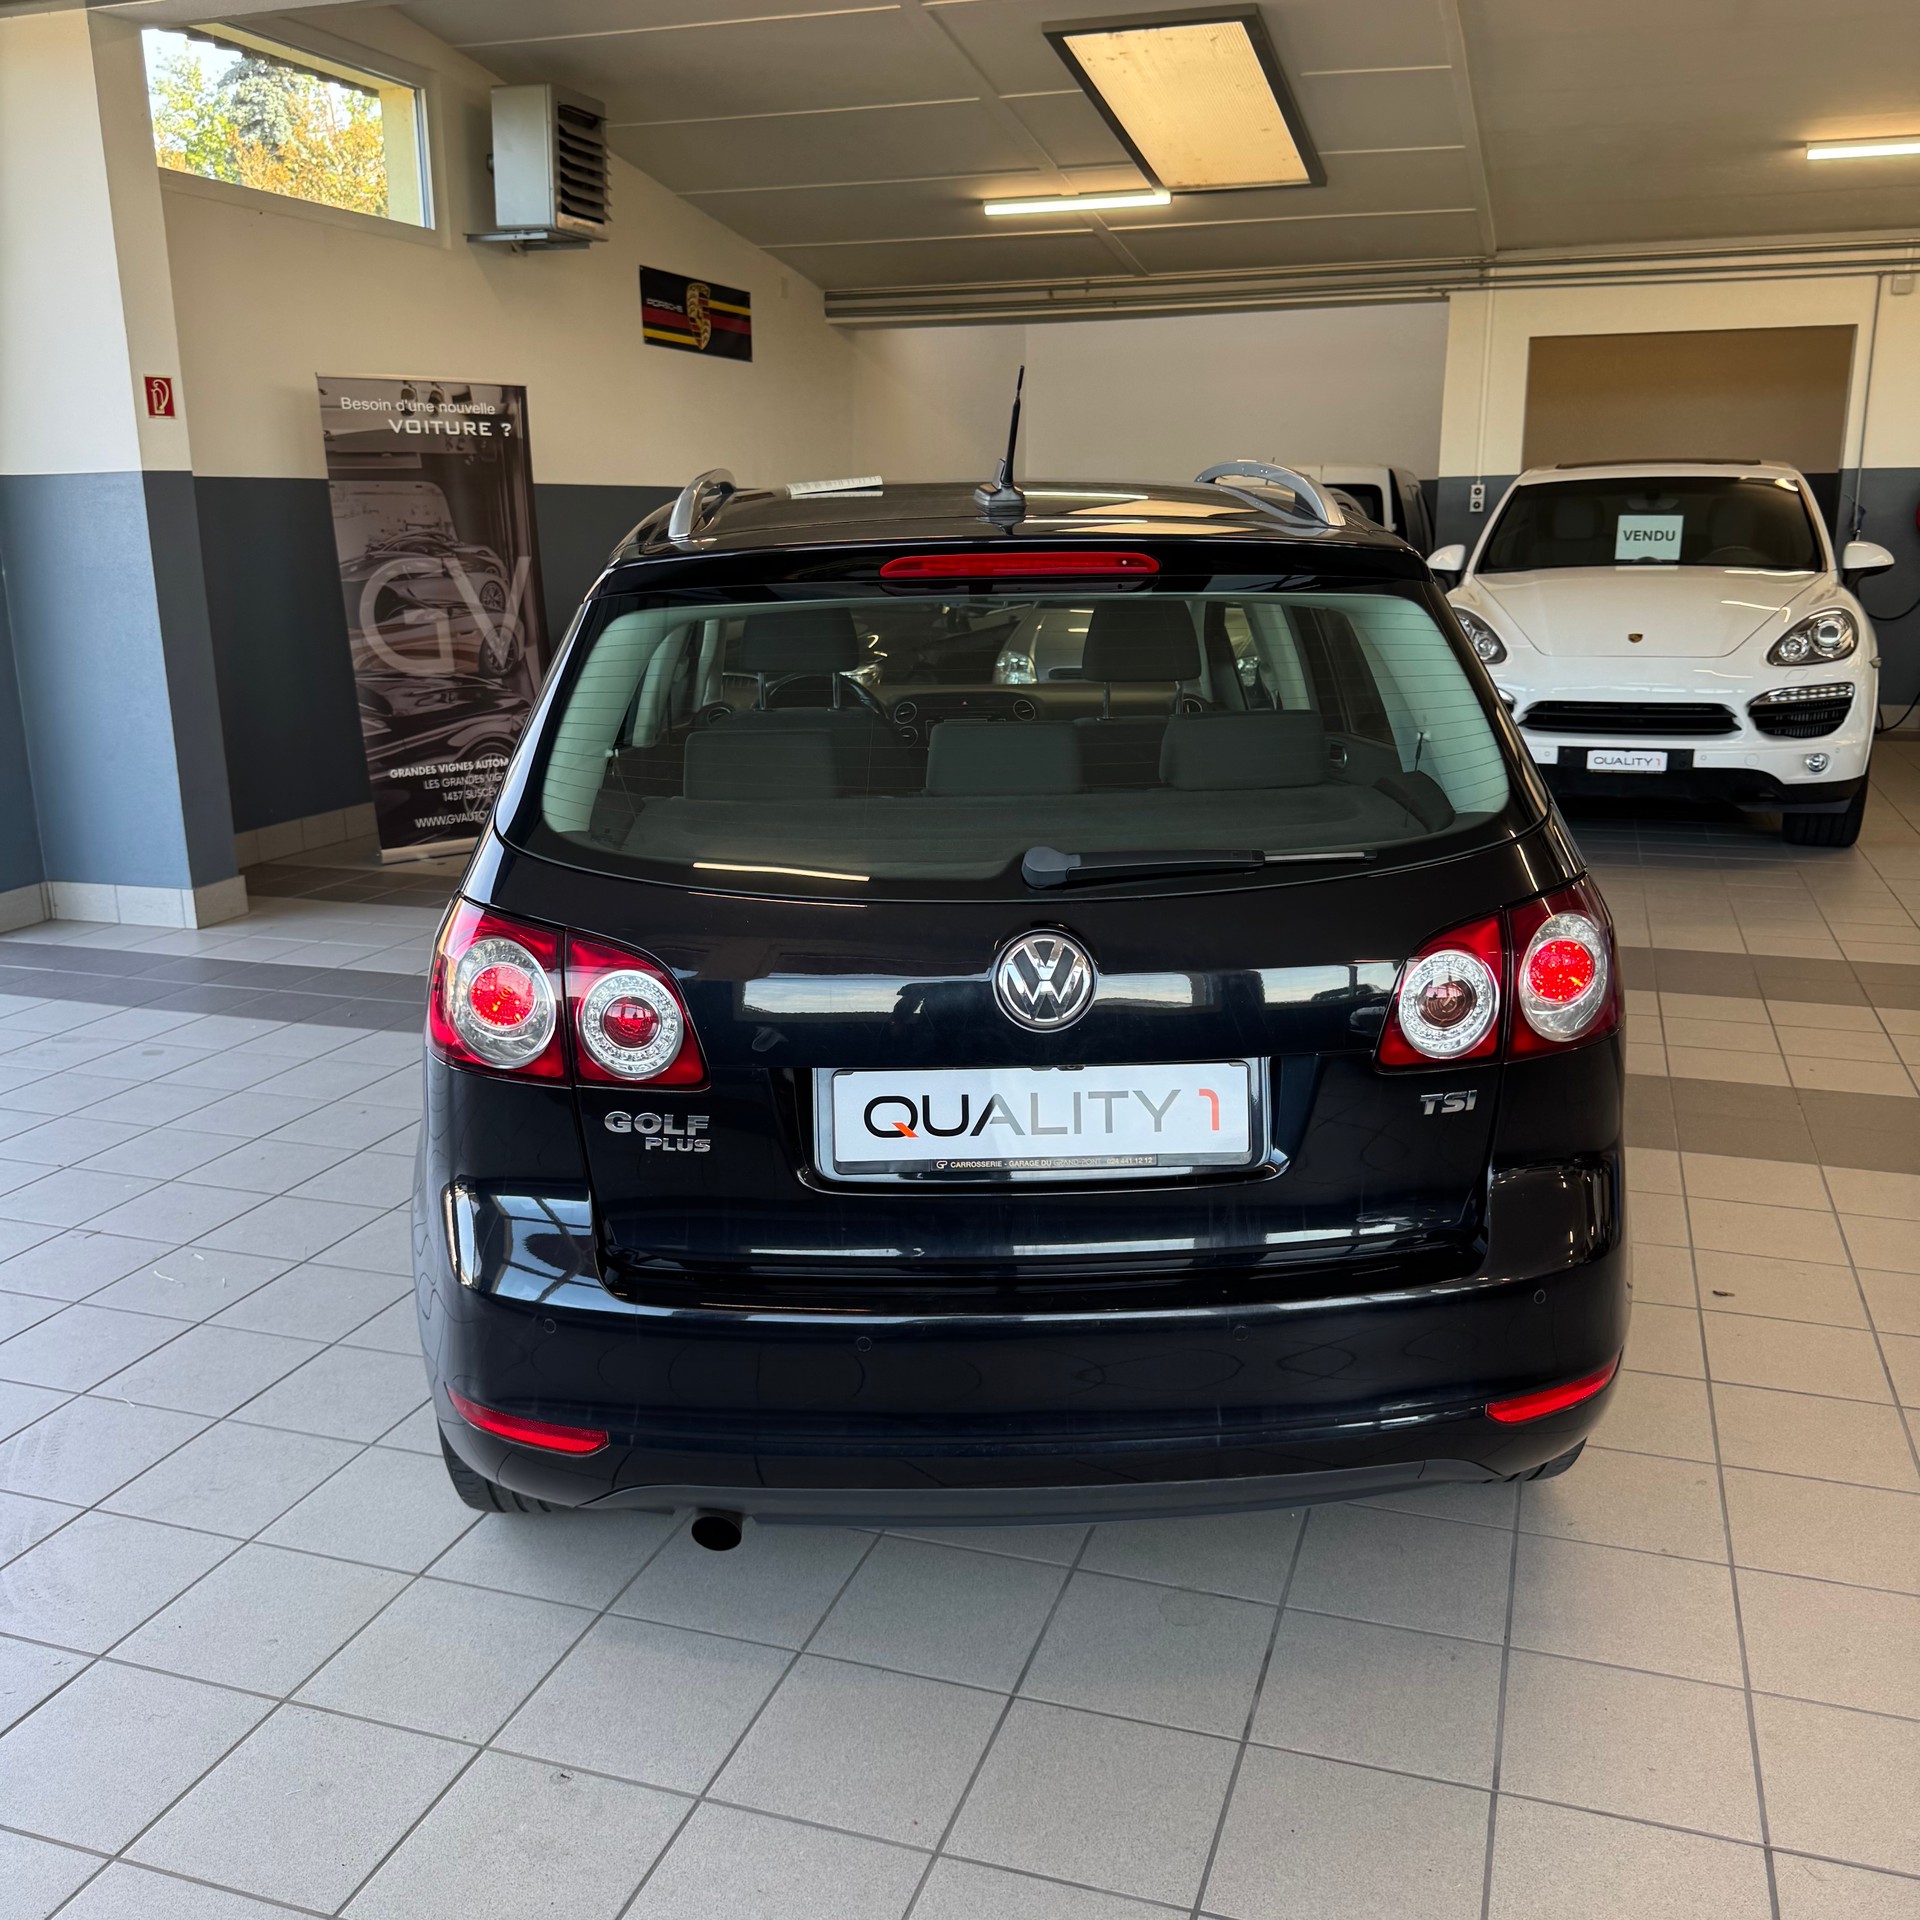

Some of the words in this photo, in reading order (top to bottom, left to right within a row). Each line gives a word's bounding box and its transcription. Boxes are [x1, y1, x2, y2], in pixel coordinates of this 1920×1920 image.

[340, 397, 392, 411] Besoin
[396, 399, 435, 413] d'une
[439, 402, 496, 415] nouvelle
[388, 419, 493, 436] VOITURE
[501, 423, 512, 437] ?
[1623, 530, 1676, 541] VENDU
[360, 556, 531, 676] GV
[390, 765, 437, 779] GRANDES
[438, 761, 474, 774] VIGNES
[1593, 756, 1653, 766] QUALITY
[1655, 758, 1661, 766] 1
[424, 779, 440, 790] LES
[441, 773, 485, 788] GRANDES
[486, 772, 504, 782] VIG
[442, 791, 463, 802] 1437
[414, 810, 489, 828] WWW.GVAUTO
[996, 932, 1093, 1029] VW
[1420, 1089, 1478, 1115] TSI
[863, 1088, 1182, 1138] QUALITY
[1197, 1088, 1221, 1132] 1
[604, 1110, 710, 1136] GOLF
[645, 1136, 711, 1152] PLUS
[950, 1160, 1002, 1168] CARROSSERIE
[1008, 1160, 1040, 1168] GARAGE
[1041, 1159, 1052, 1167] DU
[1144, 1156, 1153, 1164] 12
